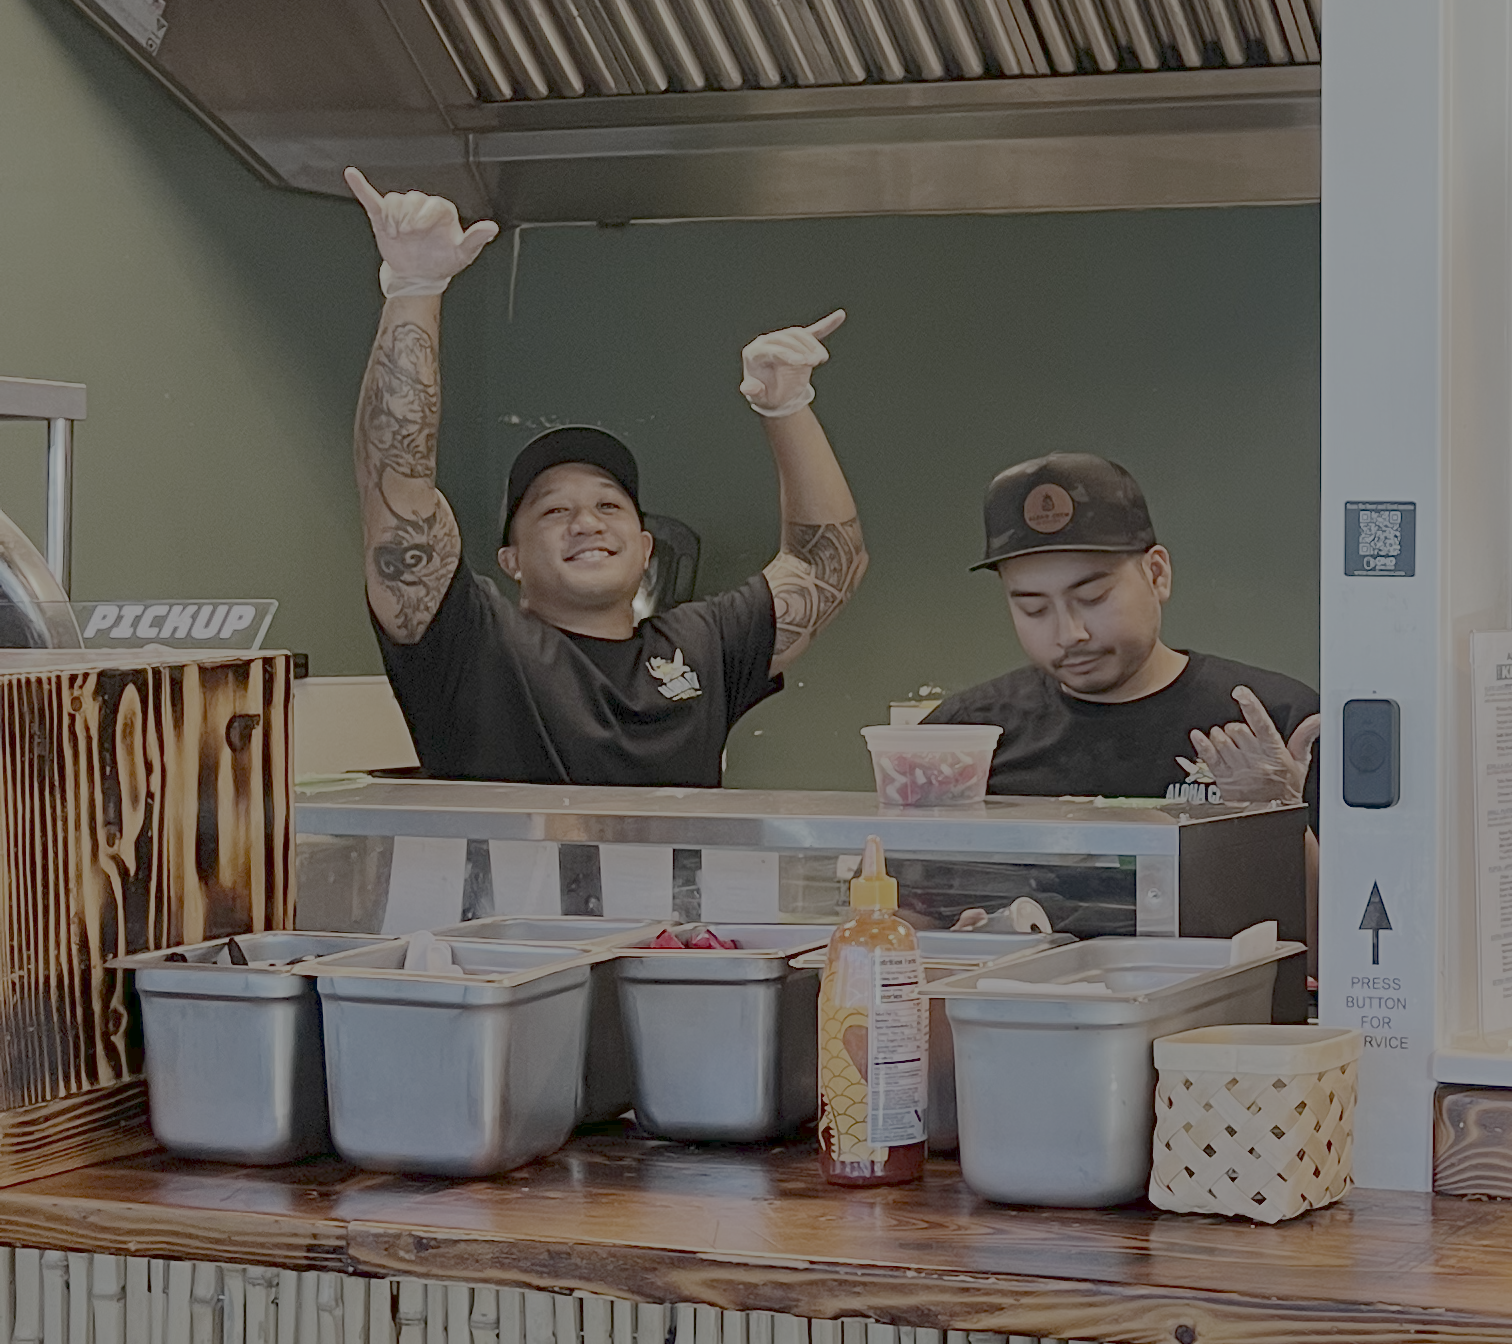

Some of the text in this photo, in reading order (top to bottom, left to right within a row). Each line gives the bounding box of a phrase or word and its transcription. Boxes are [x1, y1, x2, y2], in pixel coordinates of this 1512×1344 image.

[83, 604, 256, 640] PICKUP
[1165, 783, 1206, 805] ALOHA
[1351, 976, 1402, 991] PRESS
[1346, 995, 1407, 1010] BUTTON
[1360, 1015, 1392, 1030] FOR
[1364, 1035, 1409, 1050] RVICE
